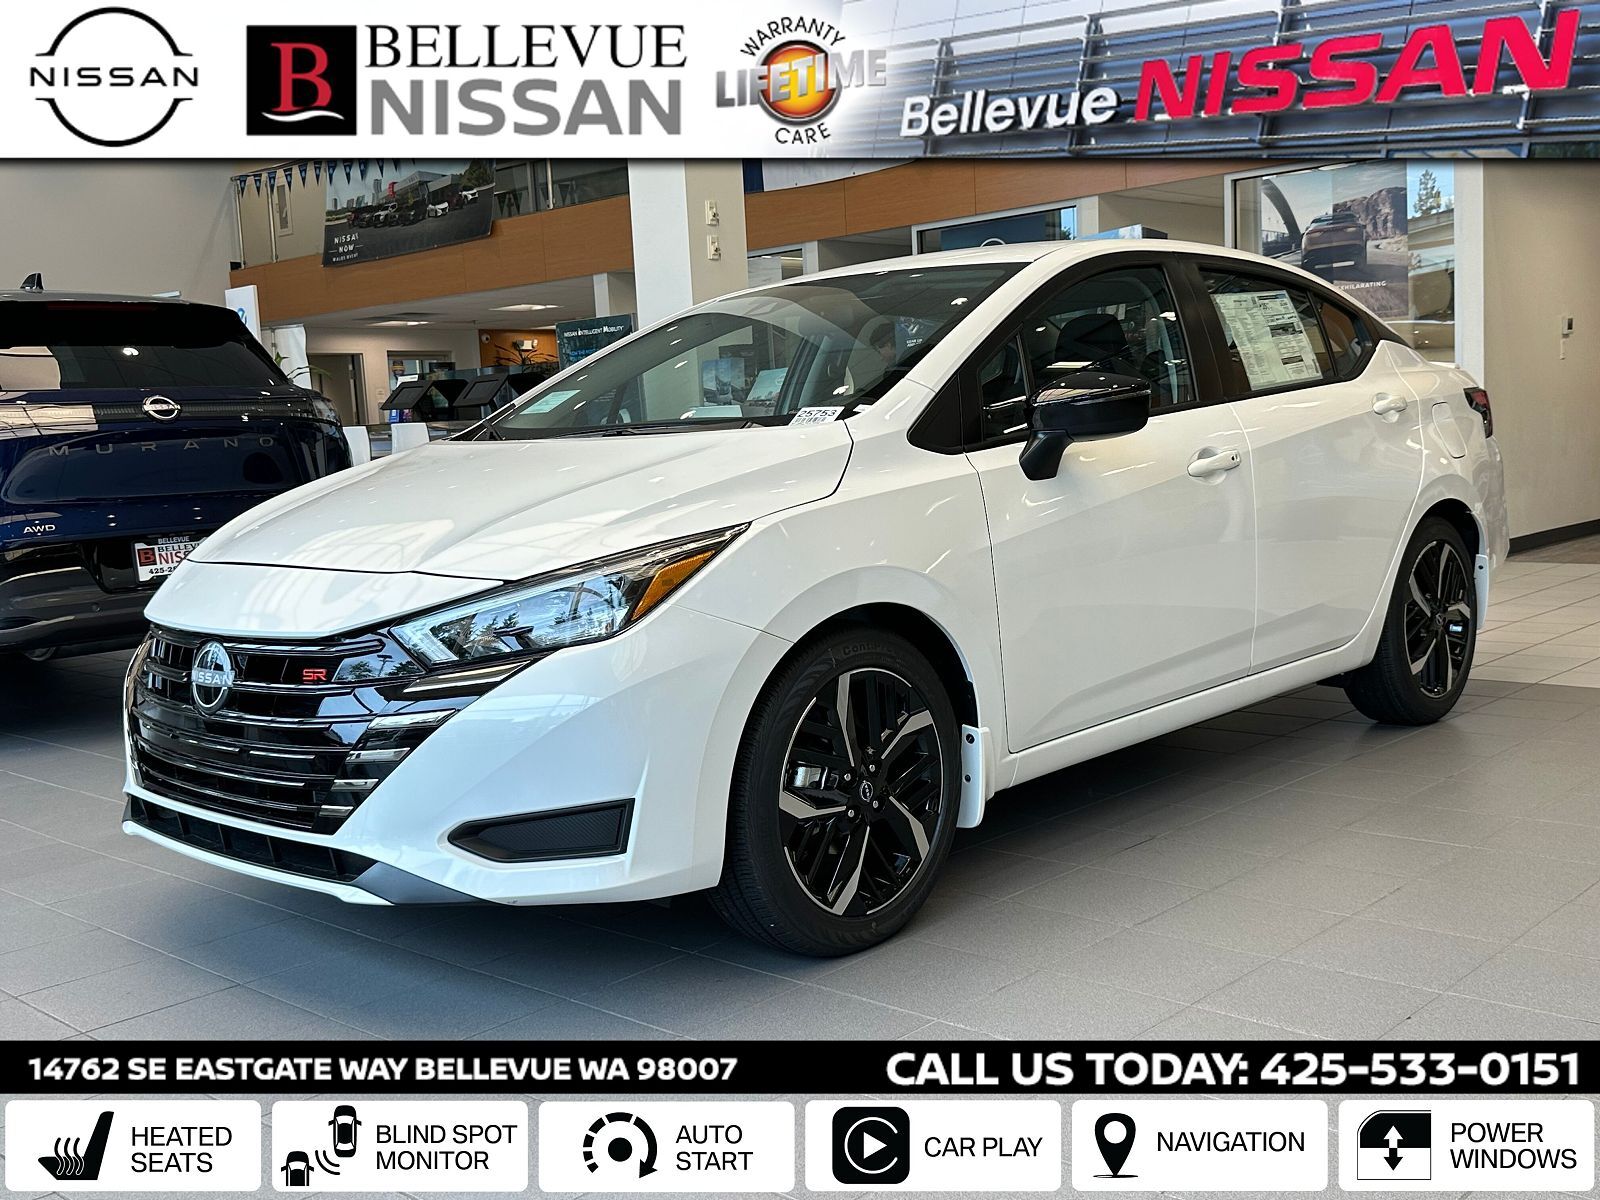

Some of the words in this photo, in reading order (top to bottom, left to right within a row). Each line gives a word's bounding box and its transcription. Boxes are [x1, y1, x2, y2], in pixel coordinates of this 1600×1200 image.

[797, 409, 838, 418] 25753
[49, 437, 275, 456] MURANO
[23, 525, 55, 533] AWD
[158, 536, 190, 544] BELLEVUE
[302, 668, 327, 681] SR
